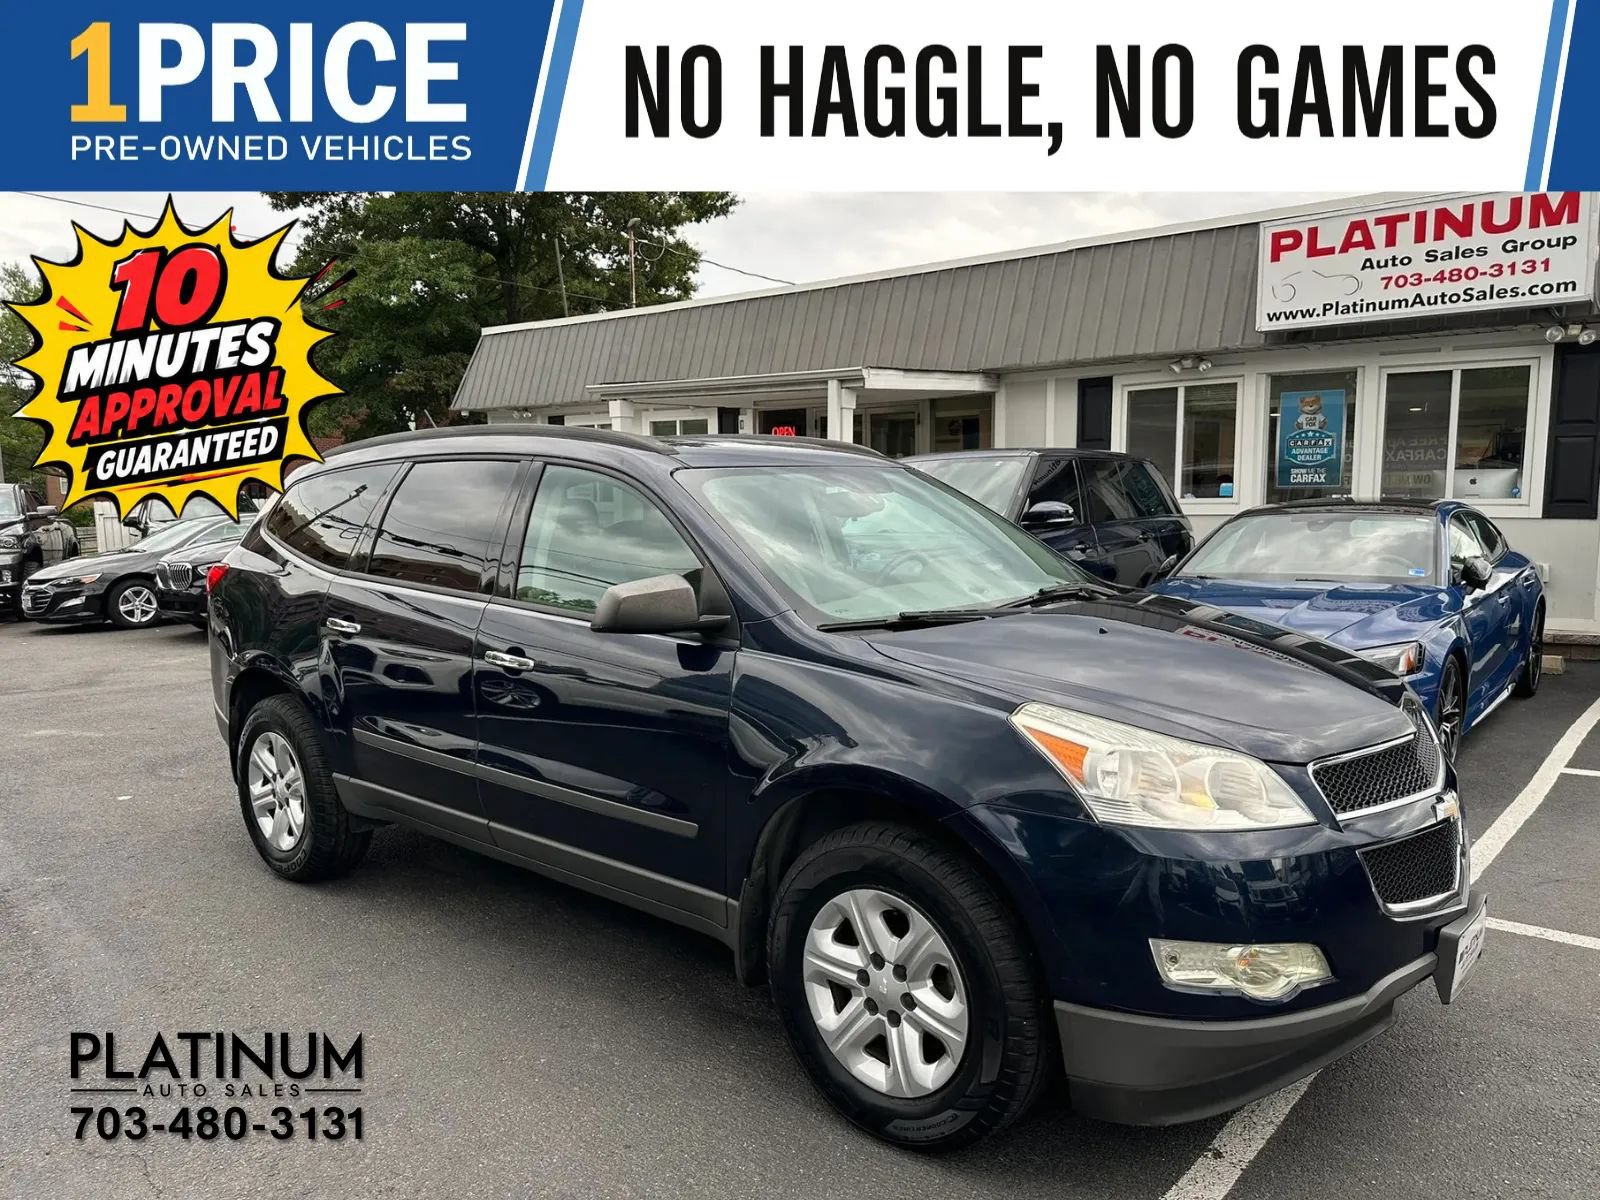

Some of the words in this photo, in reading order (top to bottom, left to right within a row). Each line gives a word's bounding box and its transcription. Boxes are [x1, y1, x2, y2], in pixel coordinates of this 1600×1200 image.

[1269, 191, 1581, 263] PLATINUM
[1360, 254, 1412, 271] Auto
[1424, 245, 1488, 263] Sales
[1501, 235, 1578, 254] Group
[1380, 257, 1552, 290] 703-480-3131
[1266, 280, 1578, 322] www.PlatinumAutoSales.com
[772, 426, 796, 437] OPEN
[1290, 438, 1332, 447] CARFAX
[1290, 473, 1327, 483] CARFAX
